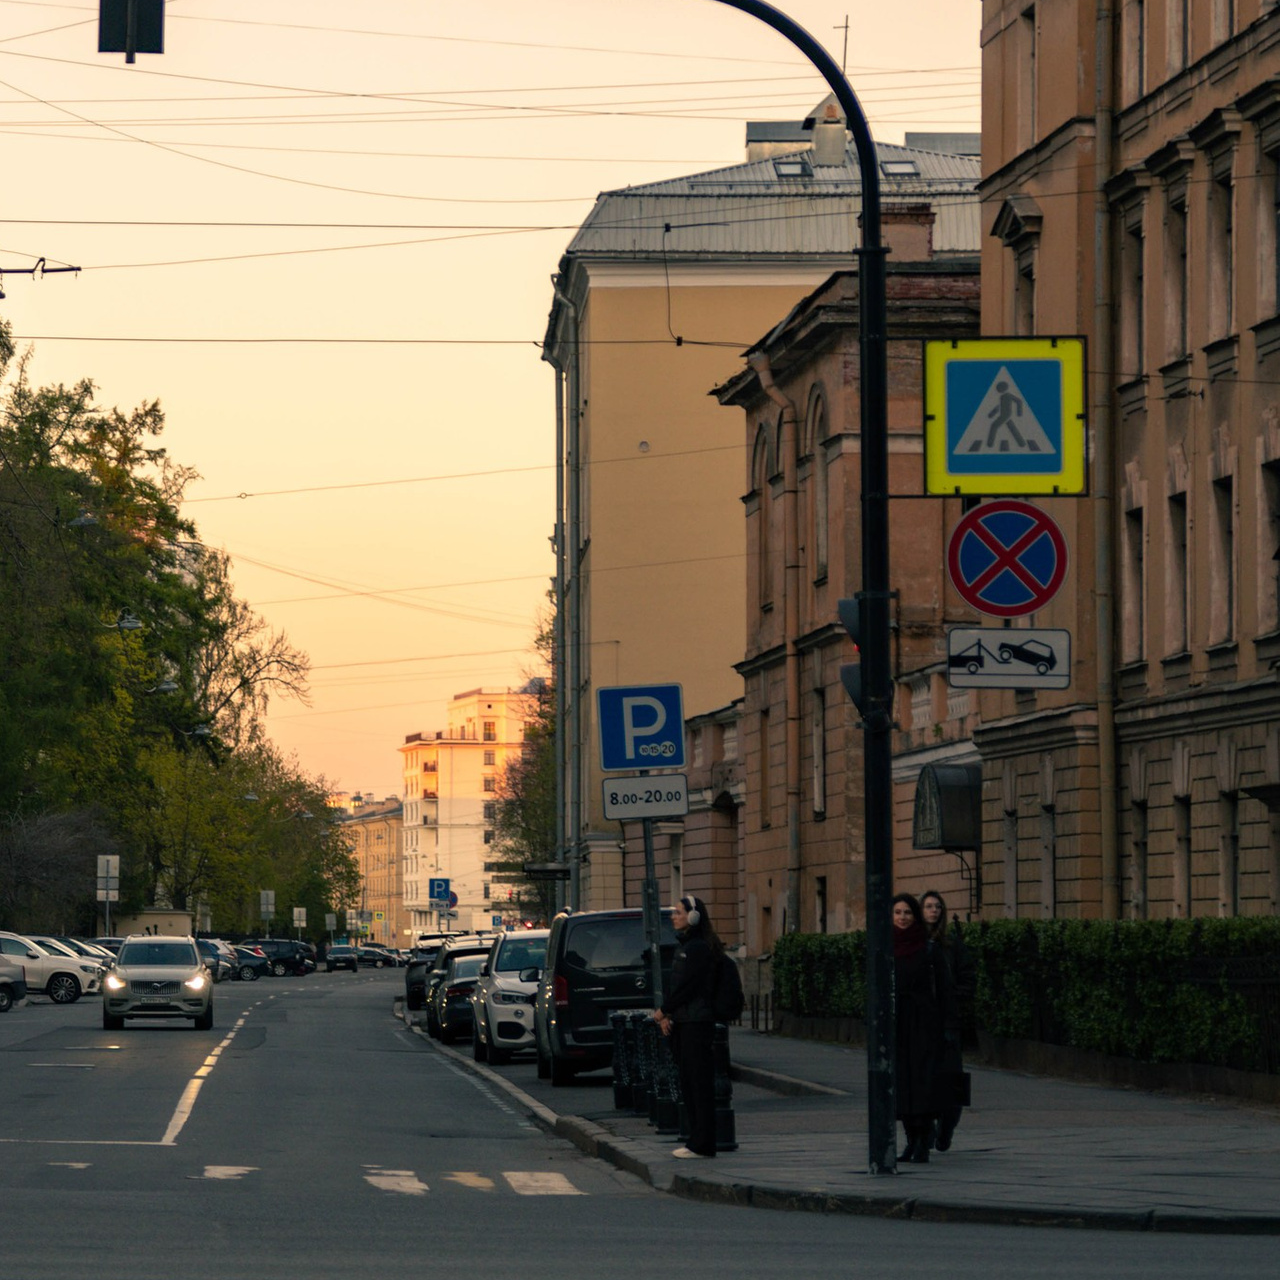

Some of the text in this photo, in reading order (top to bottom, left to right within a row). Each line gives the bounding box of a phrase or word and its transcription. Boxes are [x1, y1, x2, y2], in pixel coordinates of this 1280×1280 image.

[622, 695, 667, 760] P
[662, 743, 675, 754] 20
[610, 789, 682, 806] 8.00-20.00
[434, 881, 445, 897] P
